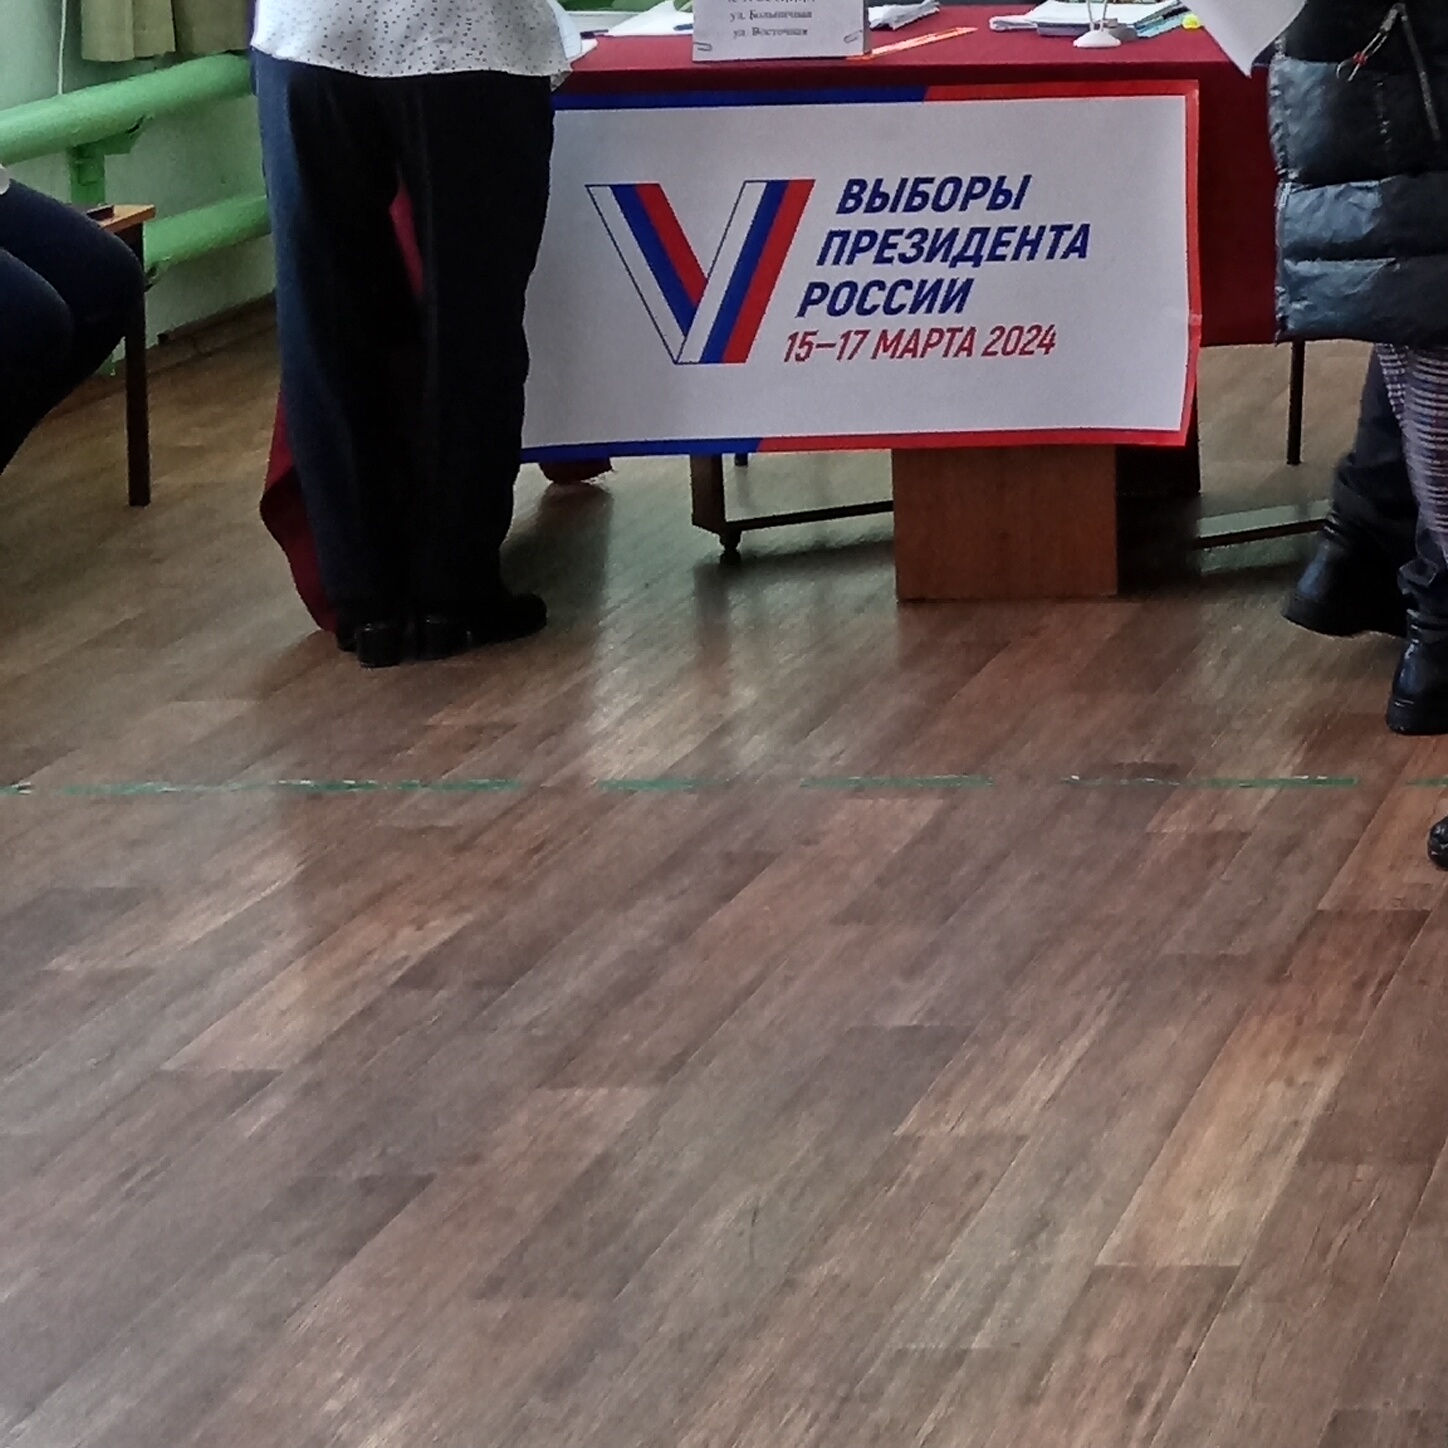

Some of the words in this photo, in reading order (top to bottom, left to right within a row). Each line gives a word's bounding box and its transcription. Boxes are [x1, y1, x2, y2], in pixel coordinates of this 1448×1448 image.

[836, 174, 1032, 214] ВЫБОРЫ
[816, 223, 1091, 268] ПРЕЗИДЕНТА
[795, 277, 973, 318] РОССИИ
[870, 325, 977, 361] МАРТА
[981, 324, 1057, 356] 2024
